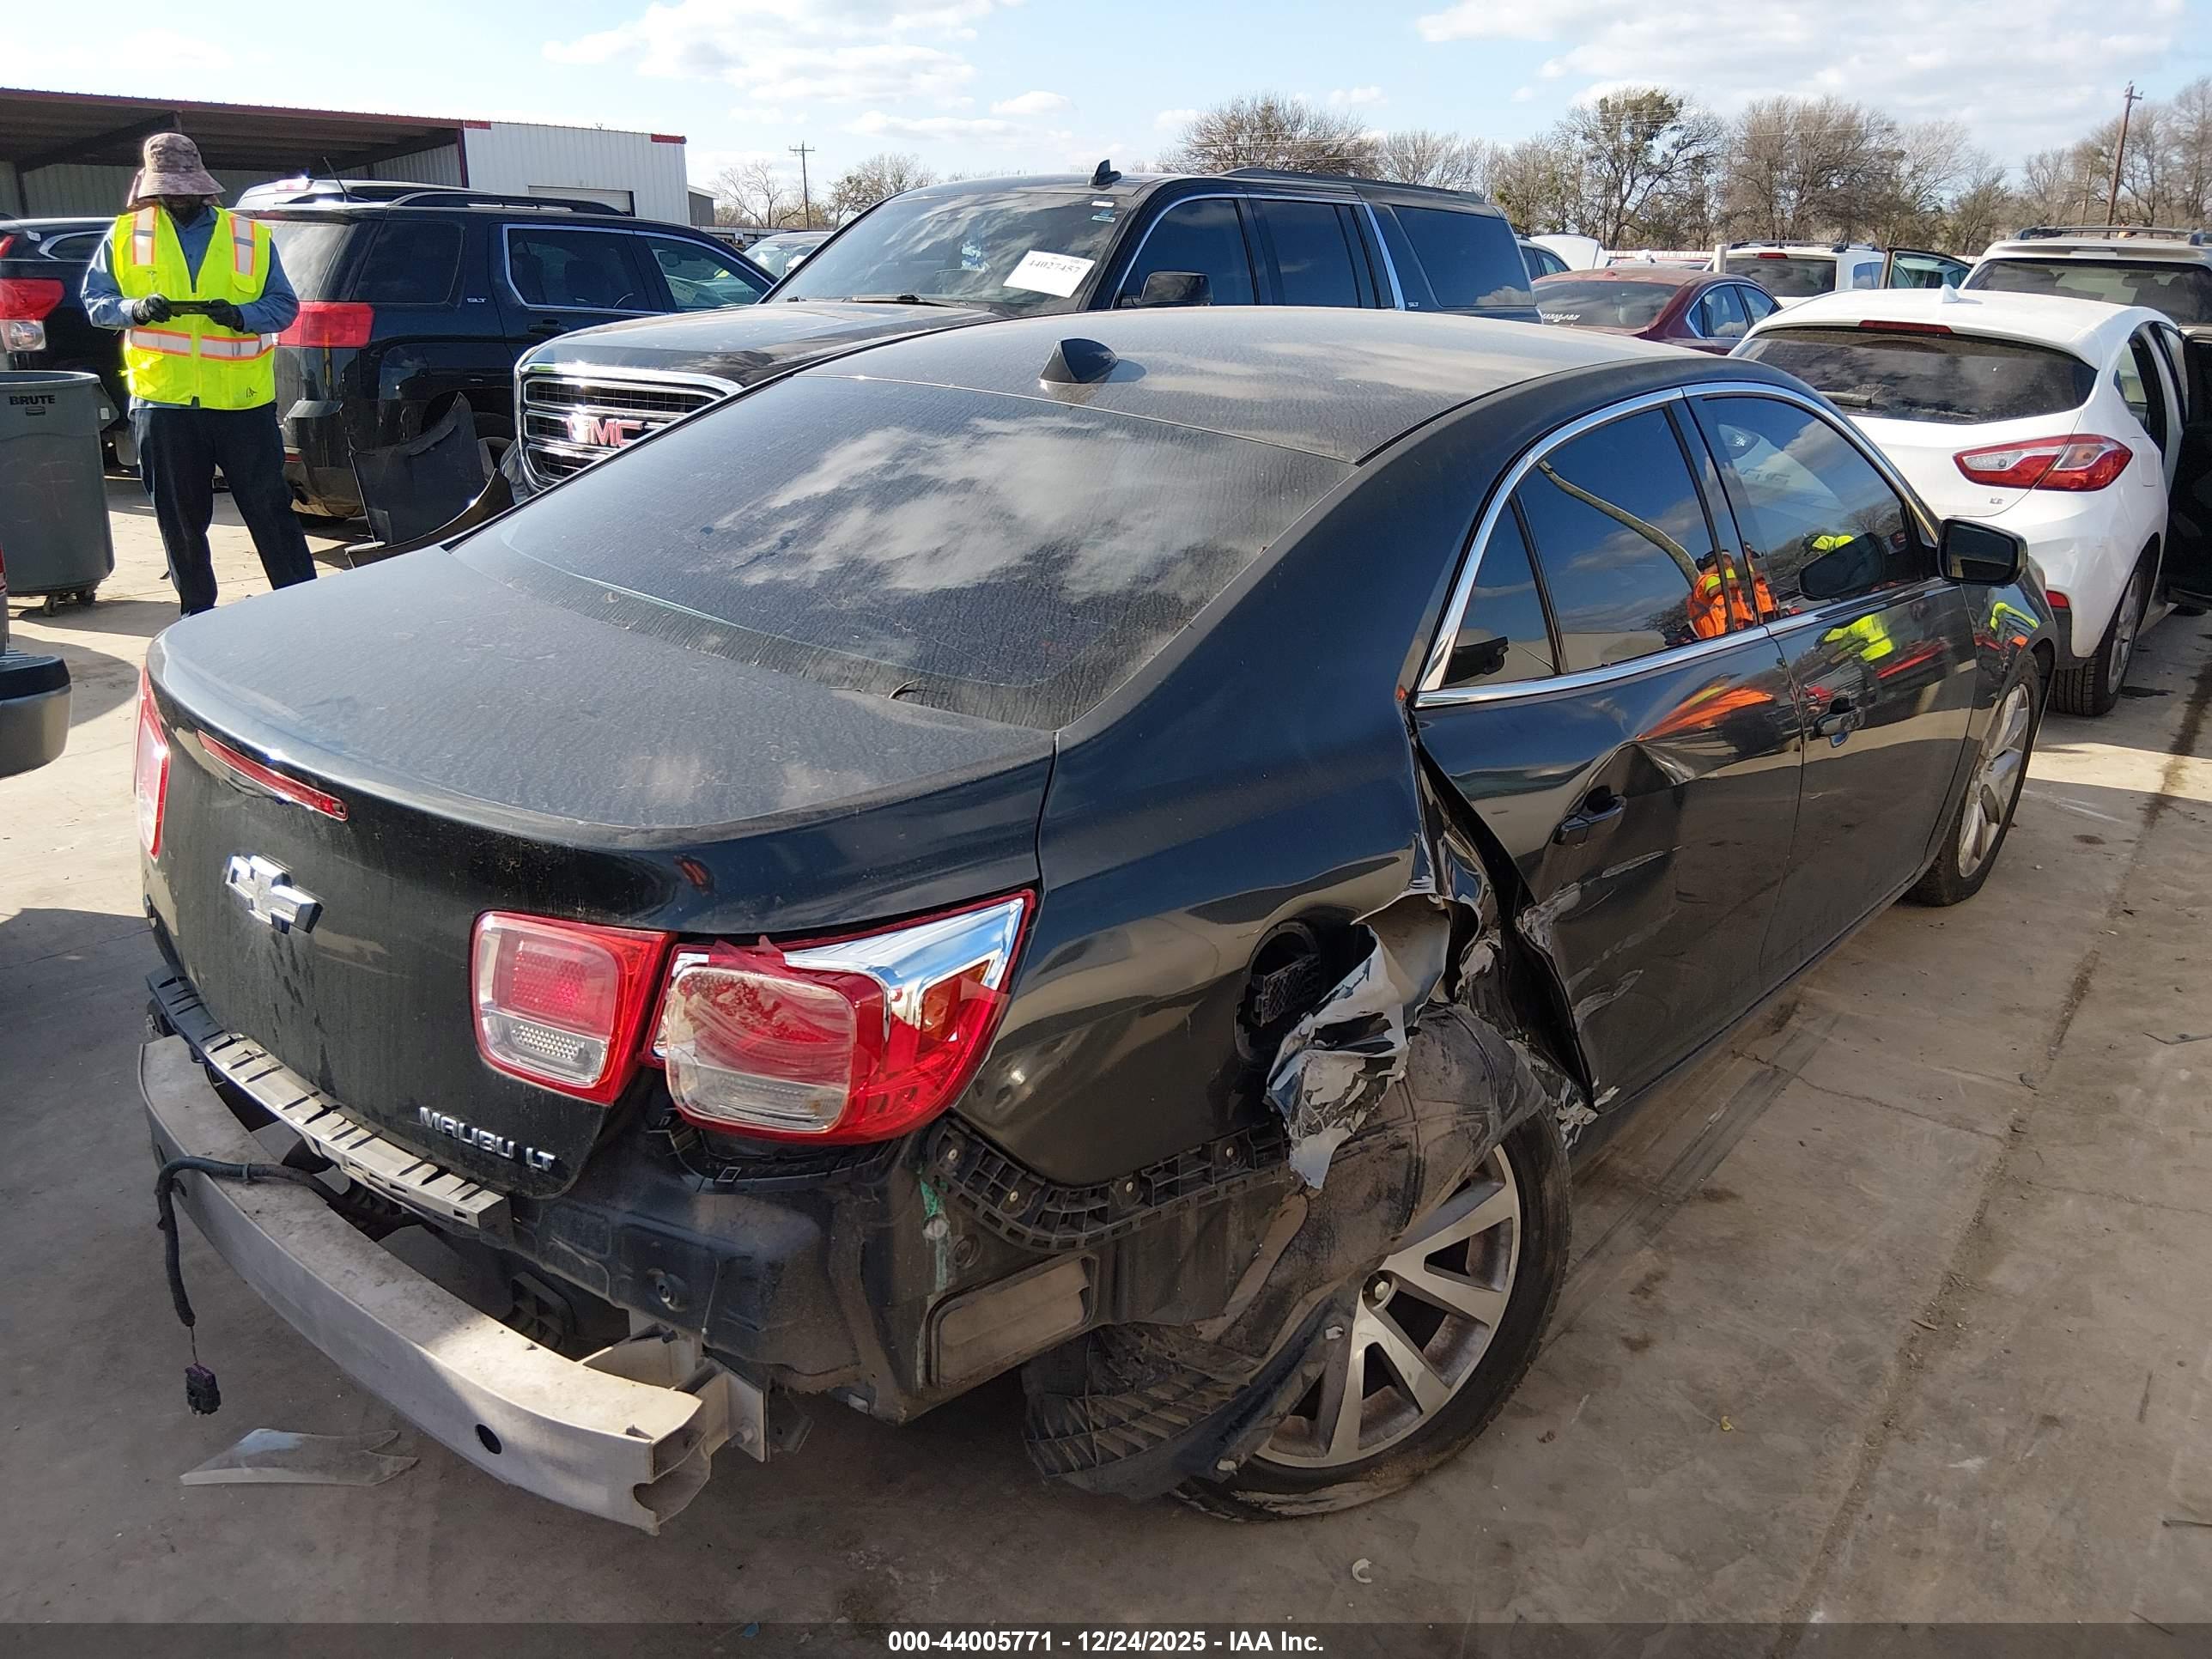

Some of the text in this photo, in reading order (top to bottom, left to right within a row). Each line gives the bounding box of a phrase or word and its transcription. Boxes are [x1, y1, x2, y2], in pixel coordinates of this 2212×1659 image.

[9, 394, 56, 405] BRUTE
[567, 413, 645, 447] GMC
[419, 1106, 556, 1172] MALIBU LT
